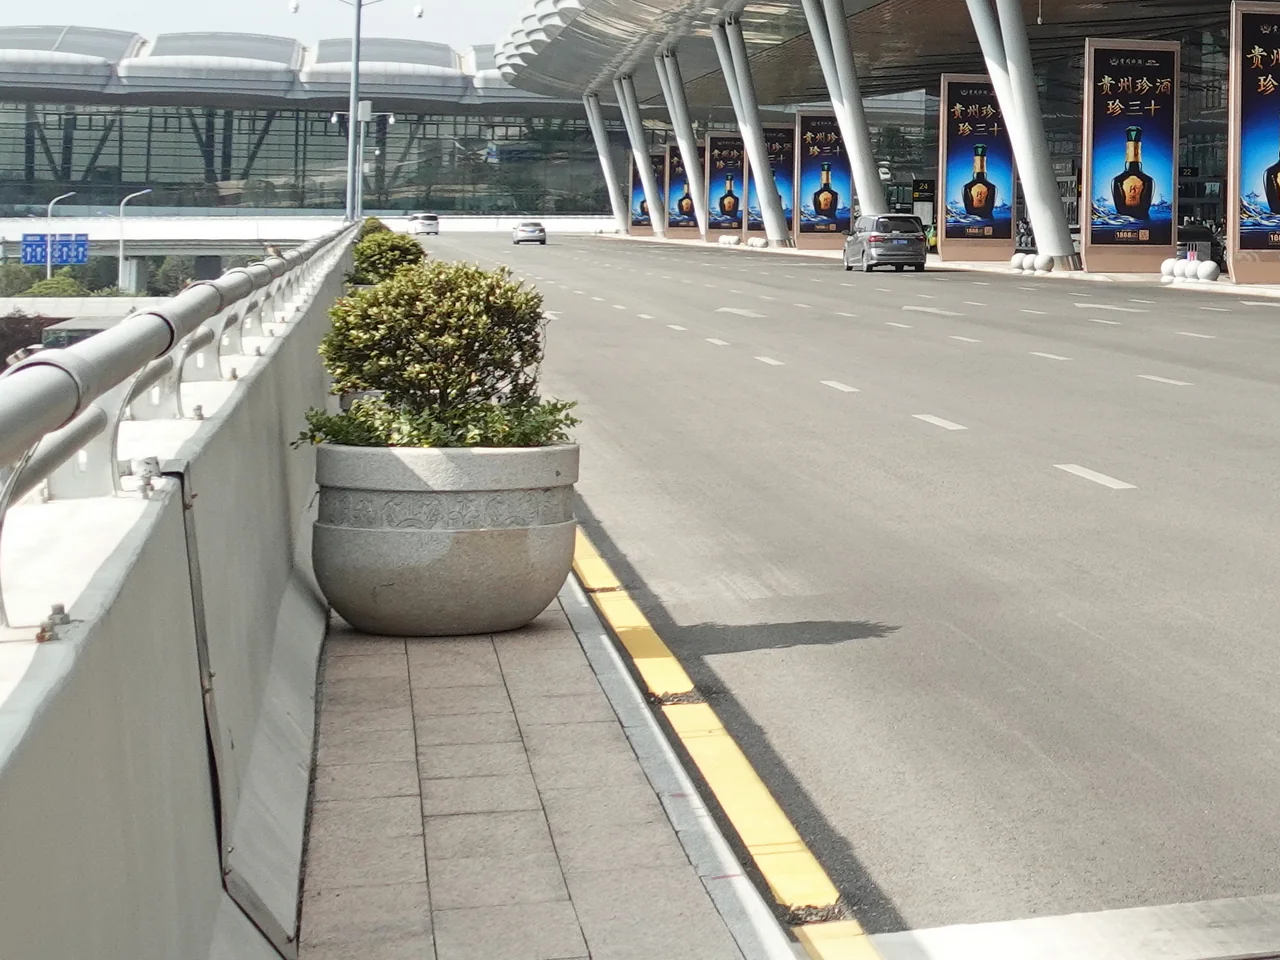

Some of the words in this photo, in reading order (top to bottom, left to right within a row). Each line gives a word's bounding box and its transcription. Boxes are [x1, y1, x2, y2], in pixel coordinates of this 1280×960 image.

[1096, 74, 1172, 96] 贵州珍酒
[950, 102, 1002, 120] 贵州珍
[1106, 98, 1161, 118] 珍三十
[957, 121, 1003, 137] 珍三十
[809, 145, 844, 157] 珍三十
[919, 182, 928, 190] 24
